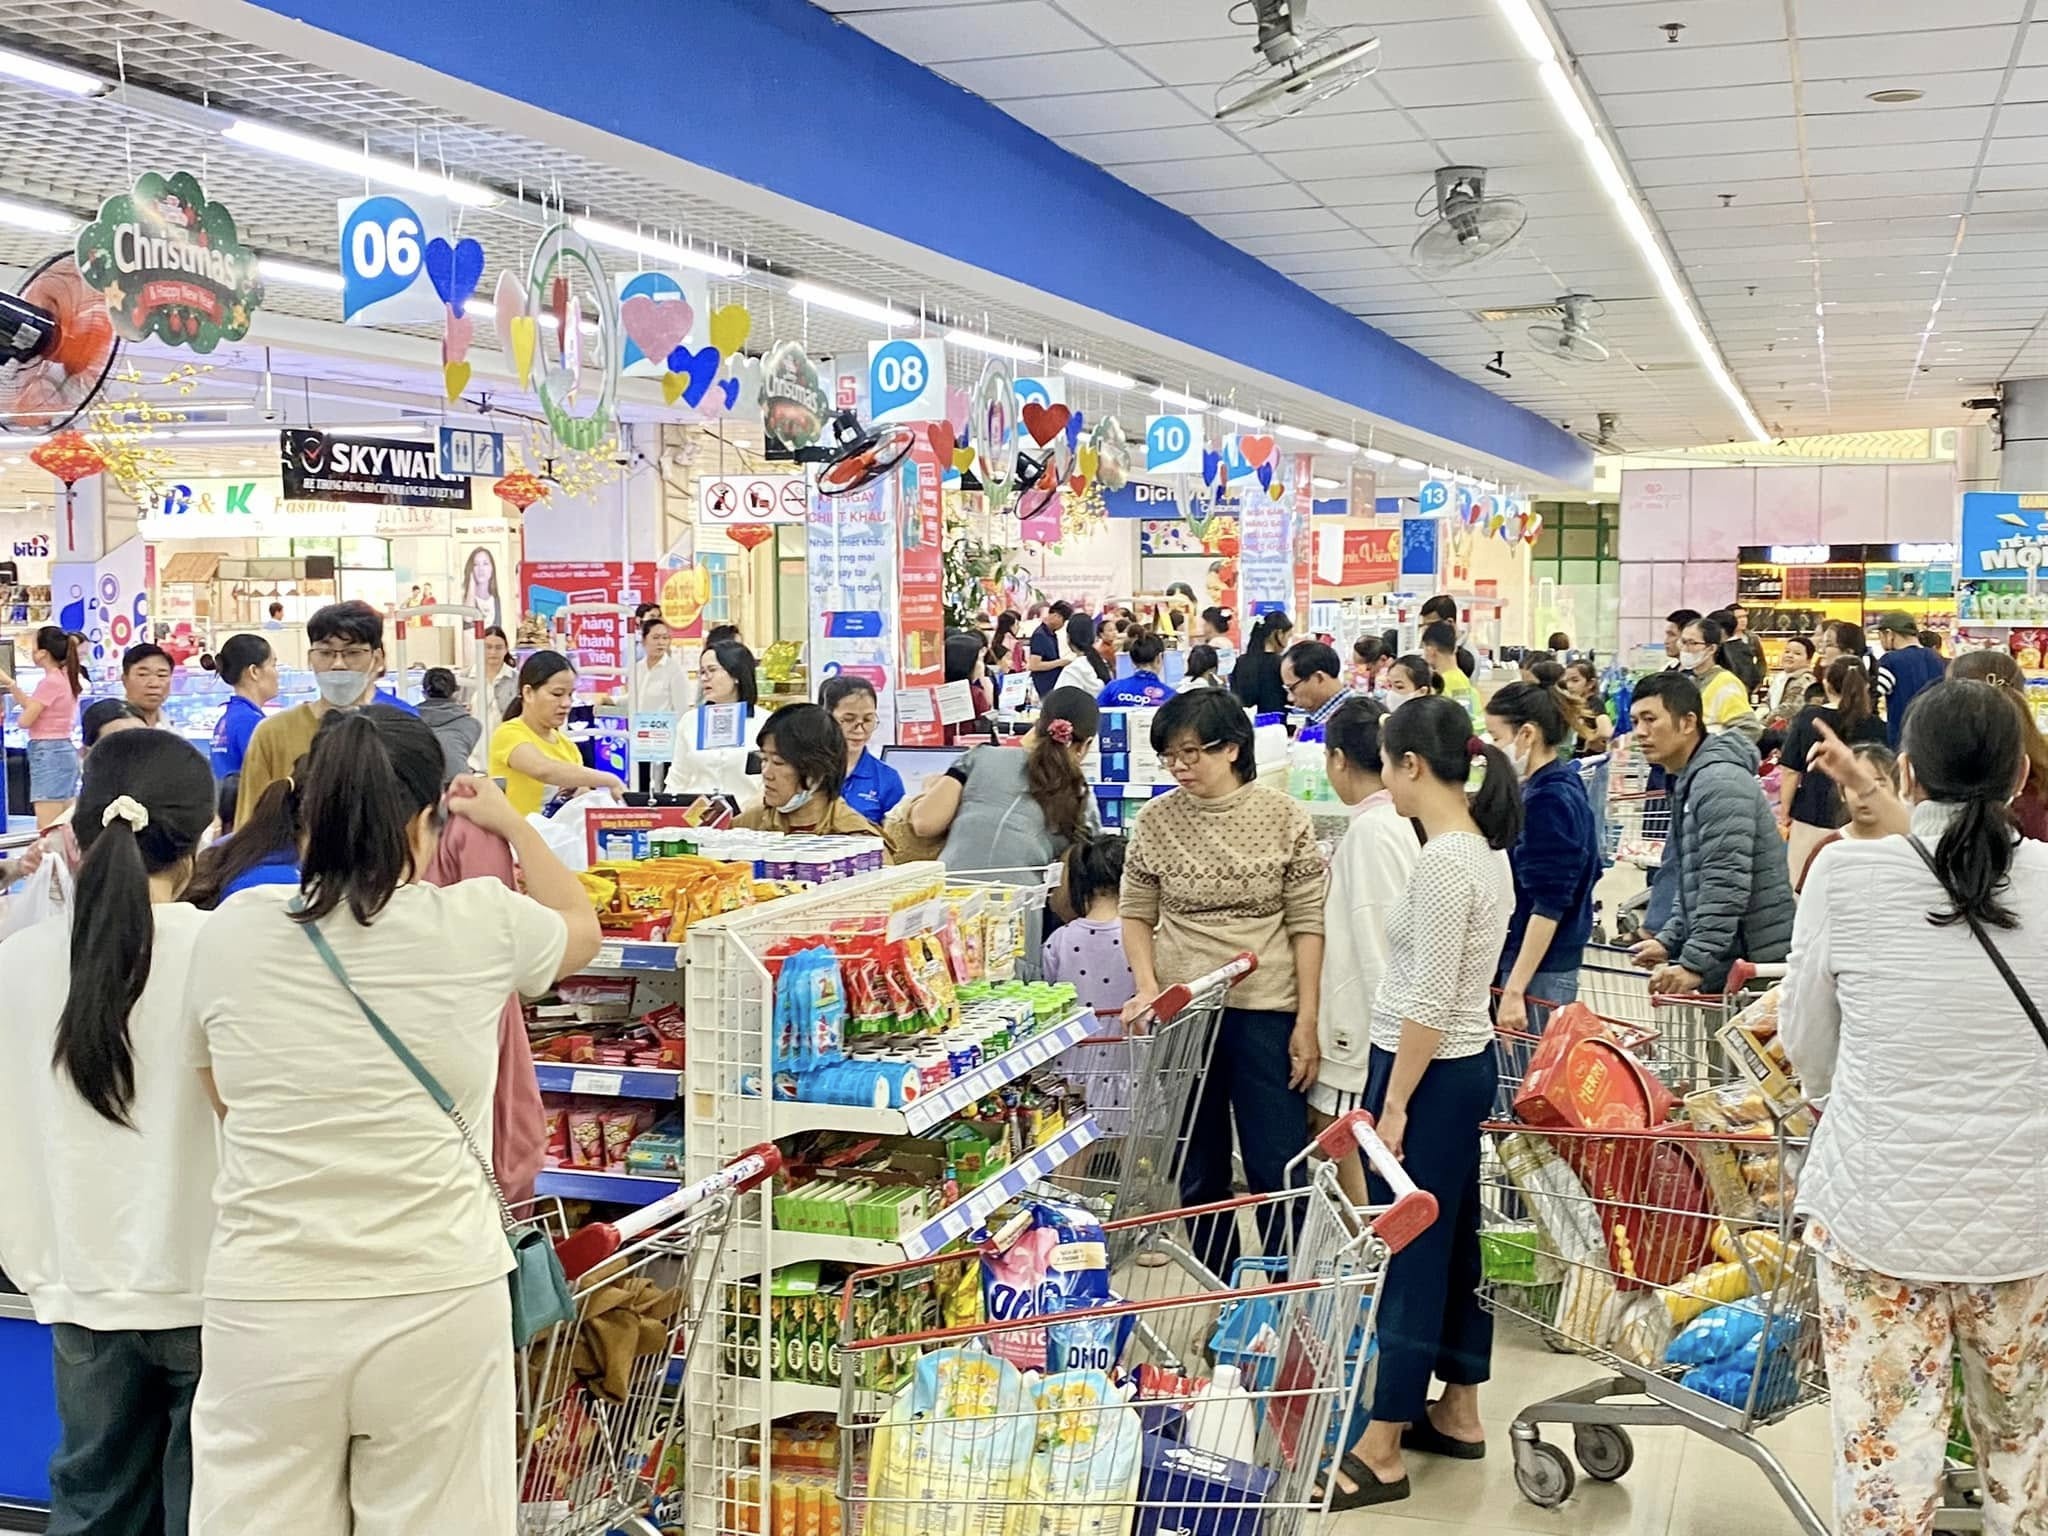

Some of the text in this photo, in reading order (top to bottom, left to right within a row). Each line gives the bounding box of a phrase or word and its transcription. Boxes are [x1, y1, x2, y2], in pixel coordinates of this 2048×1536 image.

[114, 223, 237, 290] Christmas
[352, 217, 421, 278] 06
[878, 355, 923, 393] 08
[1153, 426, 1183, 452] 10
[197, 492, 215, 514] &
[226, 483, 256, 514] K
[273, 496, 347, 514] Fashion
[1424, 488, 1444, 504] 13
[809, 511, 846, 523] CHIT
[1980, 546, 2048, 571] MO
[821, 611, 834, 638] 1
[1069, 1346, 1108, 1370] OMO
